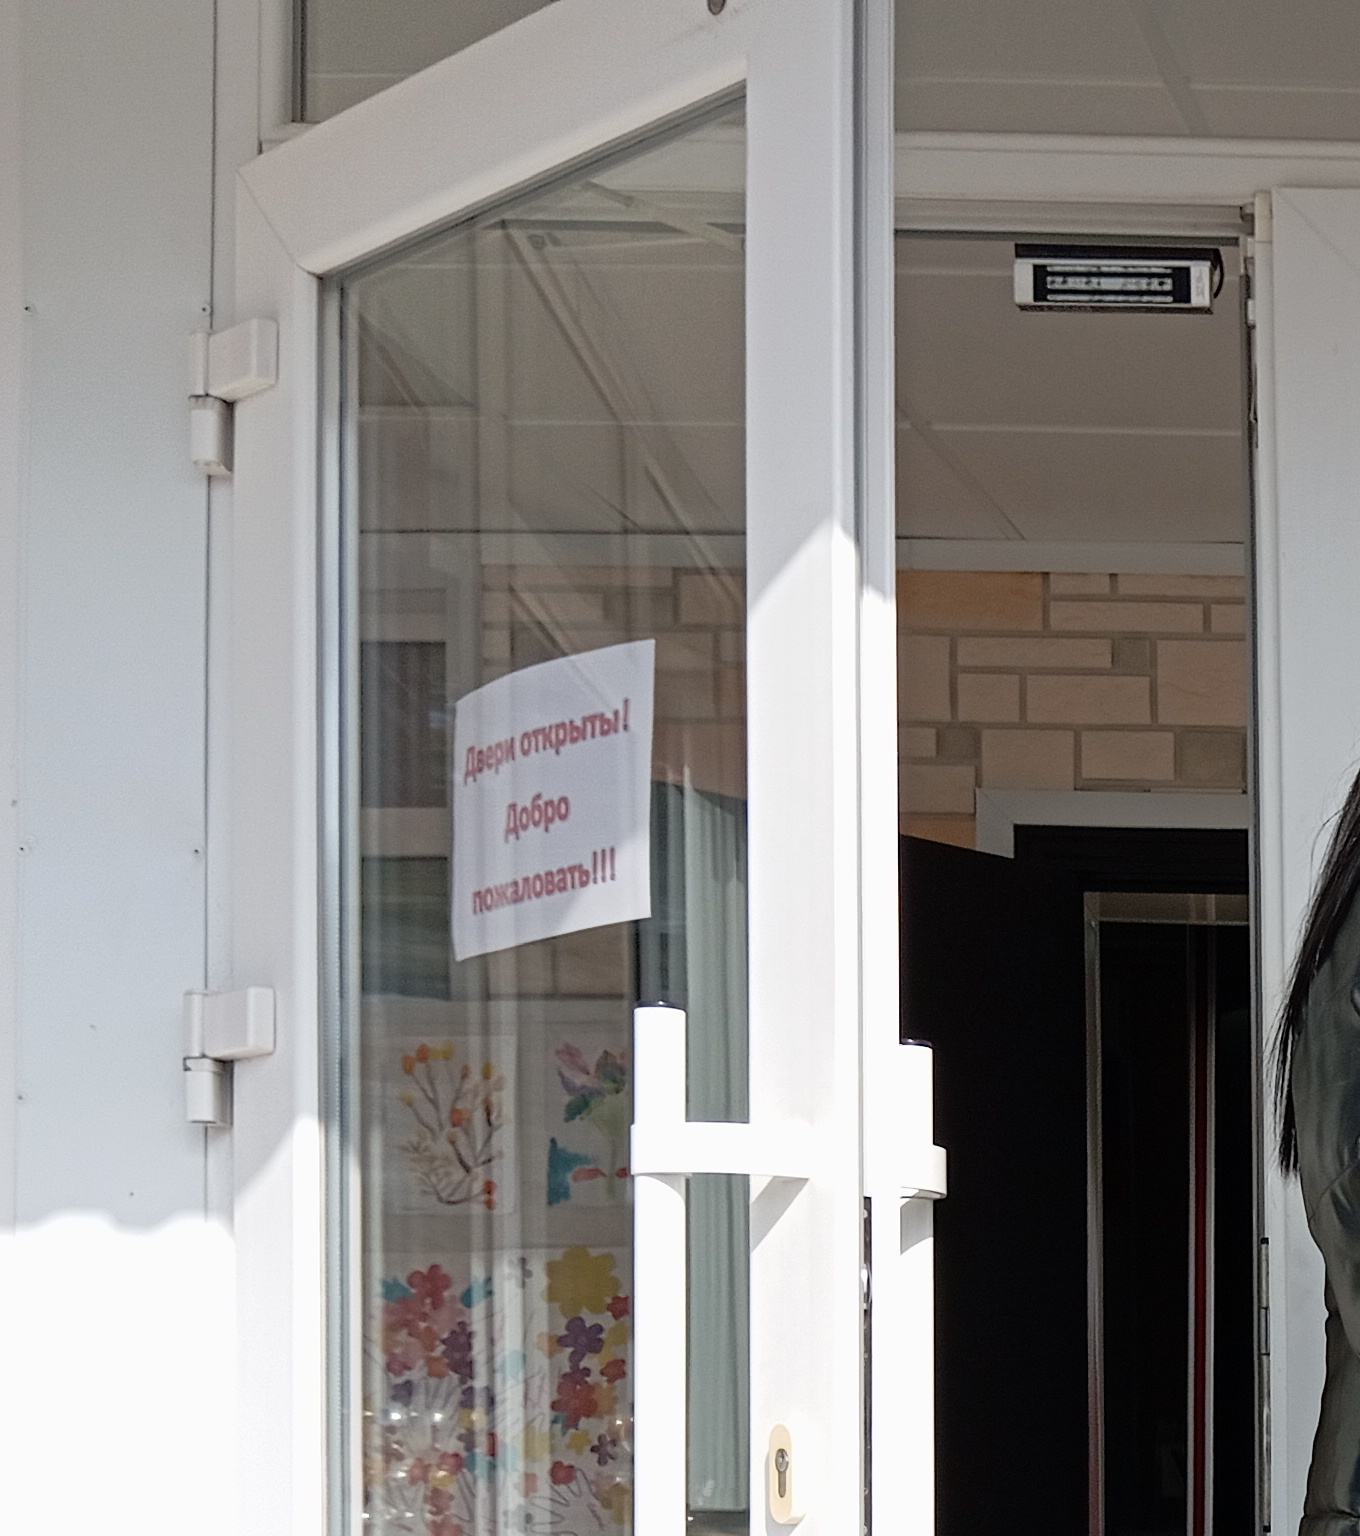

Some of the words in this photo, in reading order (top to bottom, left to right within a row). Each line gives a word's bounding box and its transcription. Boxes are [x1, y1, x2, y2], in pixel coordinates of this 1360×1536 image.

[464, 737, 516, 785] Двери
[521, 698, 631, 756] открыты!
[504, 792, 571, 843] Добро
[471, 847, 618, 916] пожаловать!!!
